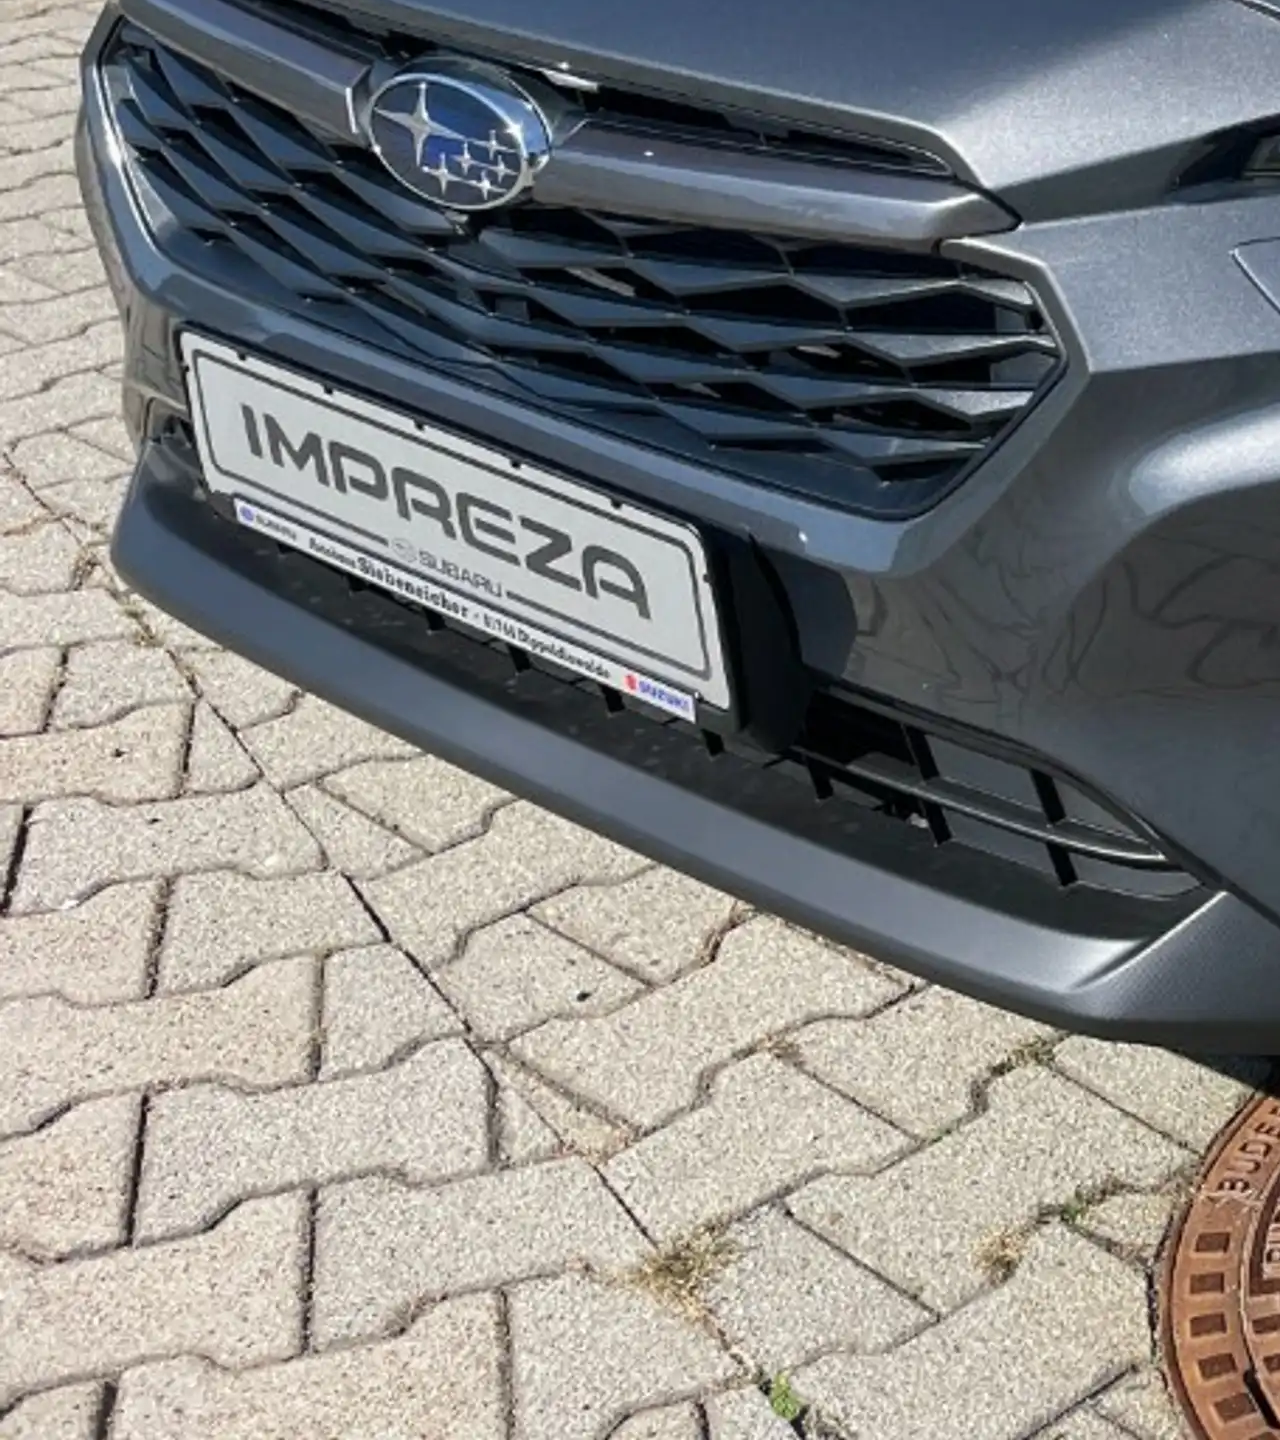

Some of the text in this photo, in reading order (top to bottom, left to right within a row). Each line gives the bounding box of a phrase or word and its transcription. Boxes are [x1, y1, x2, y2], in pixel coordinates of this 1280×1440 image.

[242, 405, 651, 620] IMPREZA
[418, 547, 502, 598] SUBARU
[357, 556, 468, 619] Siebeneicher
[638, 679, 690, 709] SUZUKI
